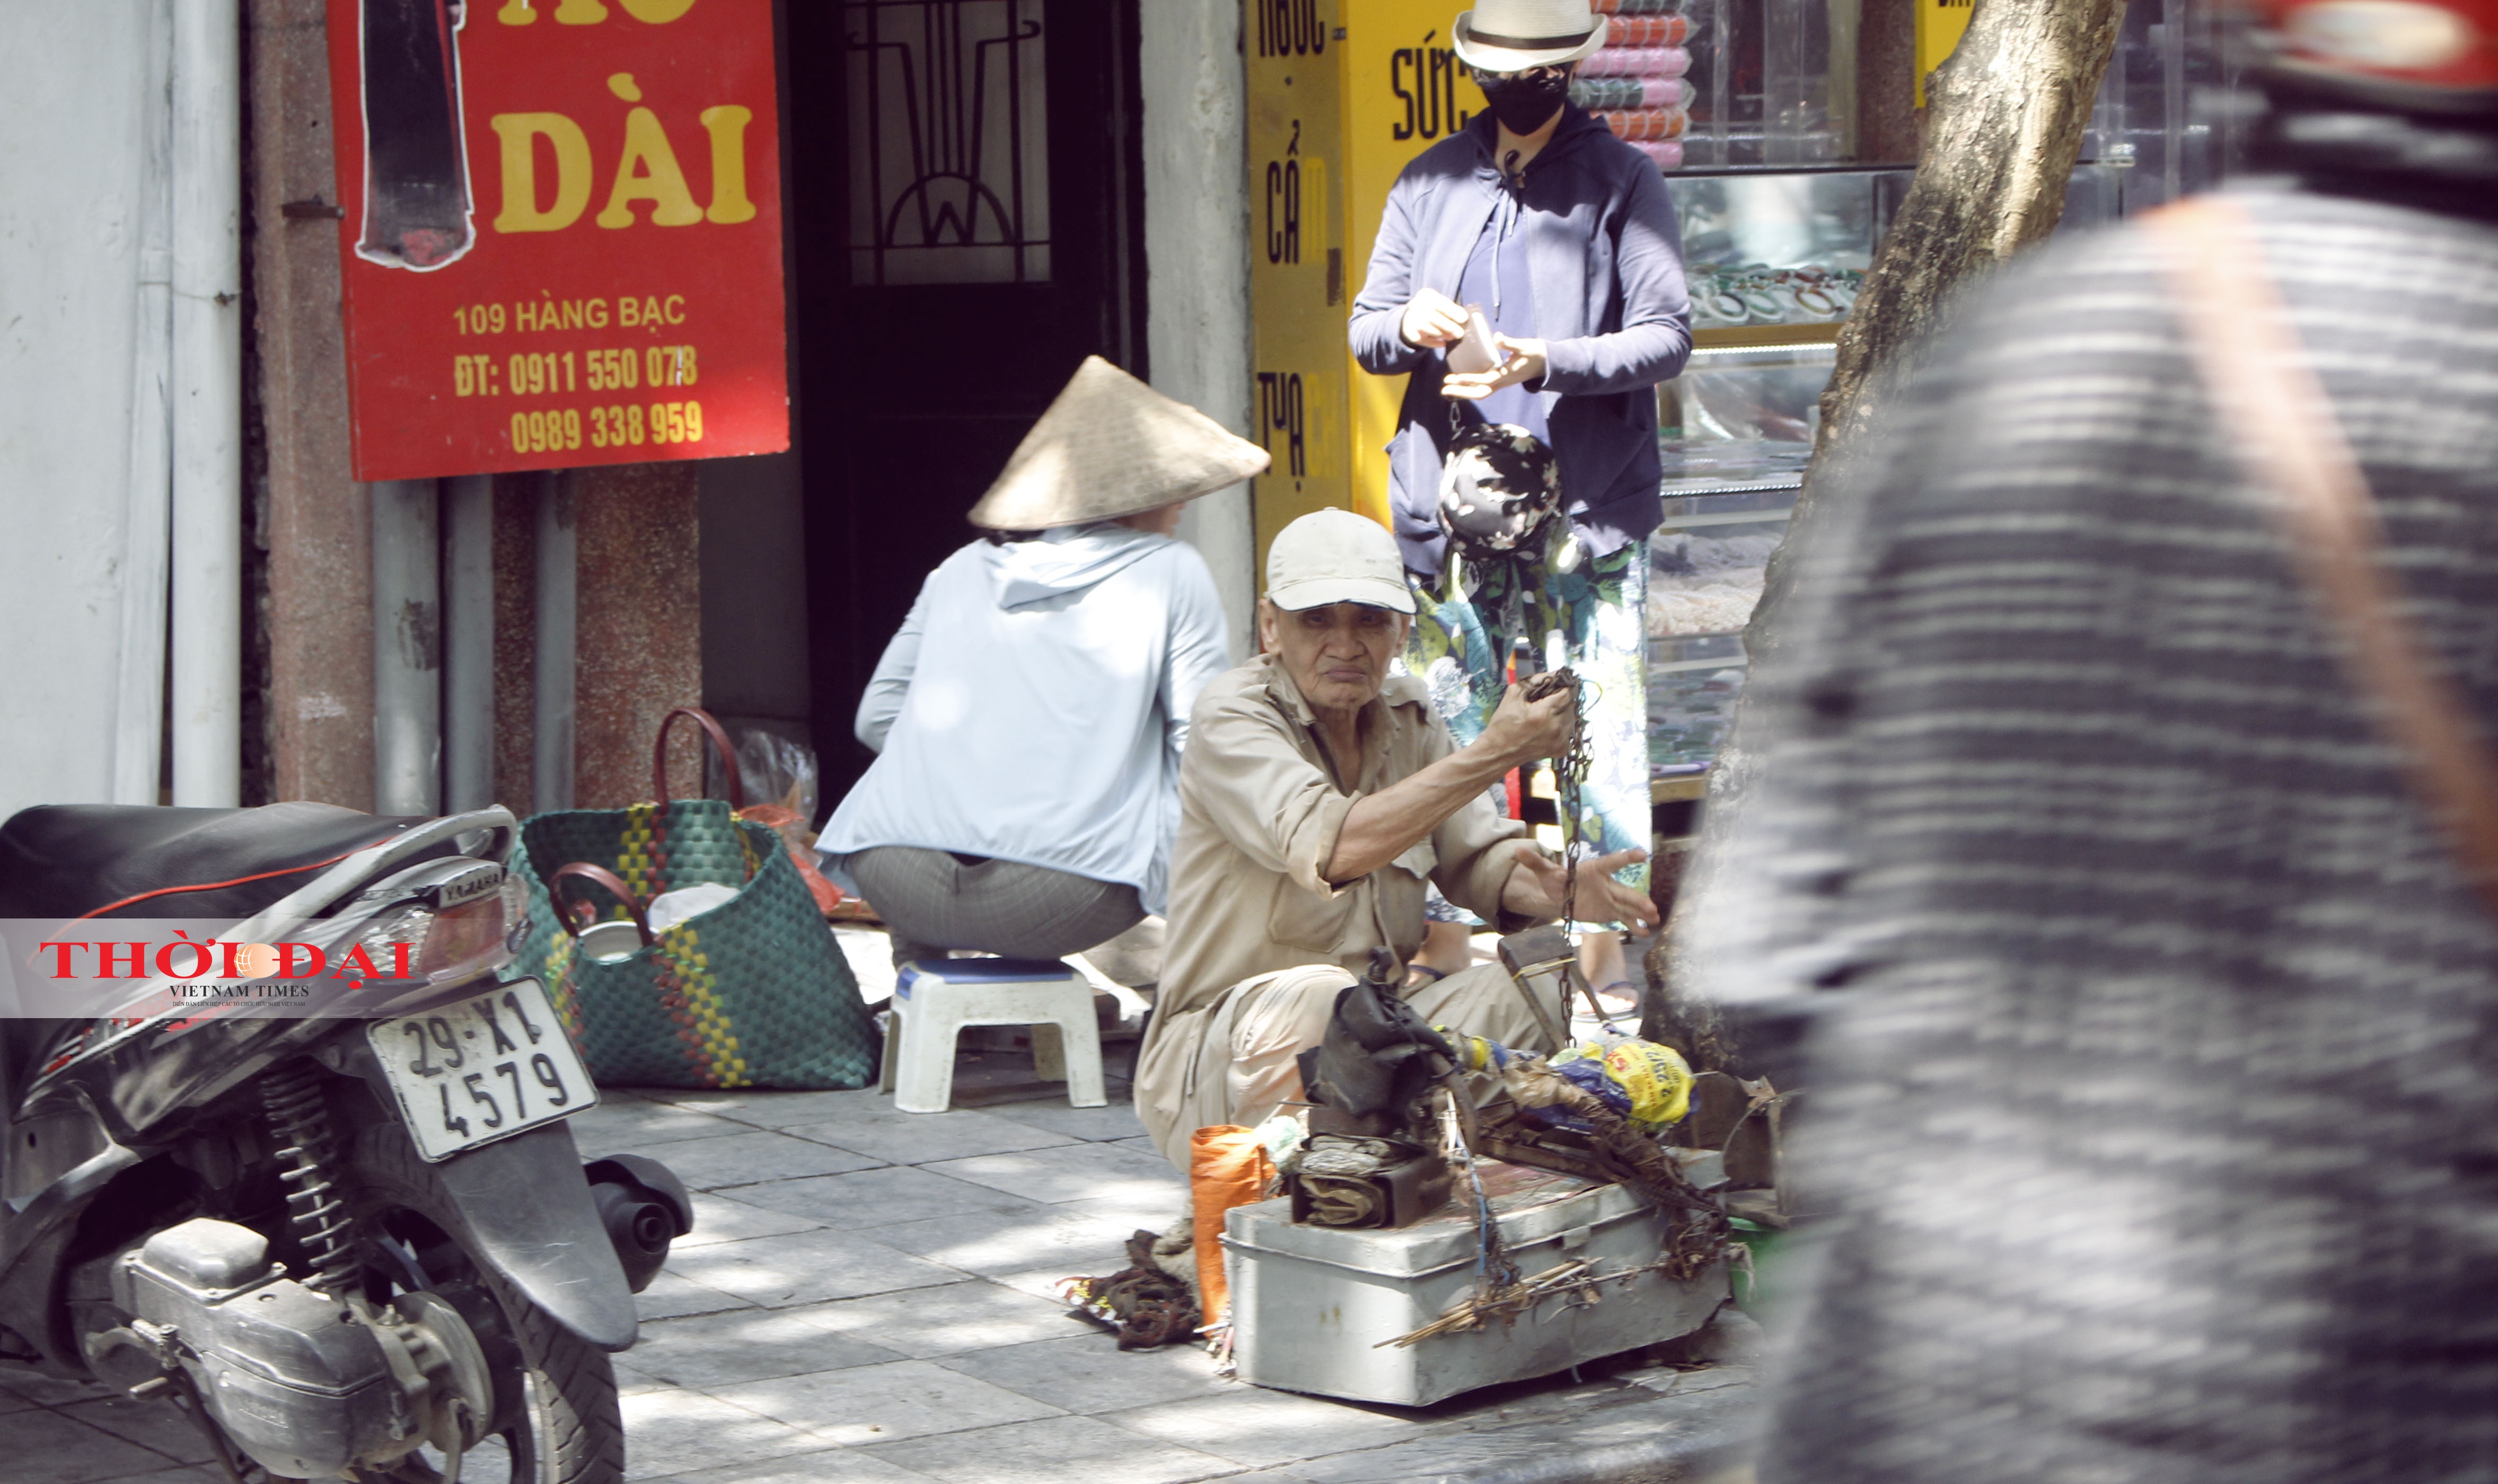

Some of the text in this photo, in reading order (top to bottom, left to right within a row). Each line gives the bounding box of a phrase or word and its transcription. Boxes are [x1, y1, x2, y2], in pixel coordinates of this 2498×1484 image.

[491, 72, 757, 233] DÀI
[454, 289, 685, 335] 109 HÀNG BẠC
[454, 344, 698, 396] ĐT: 0911 550 078
[511, 401, 703, 454] 0989 338 959
[440, 1053, 568, 1138] 4579
